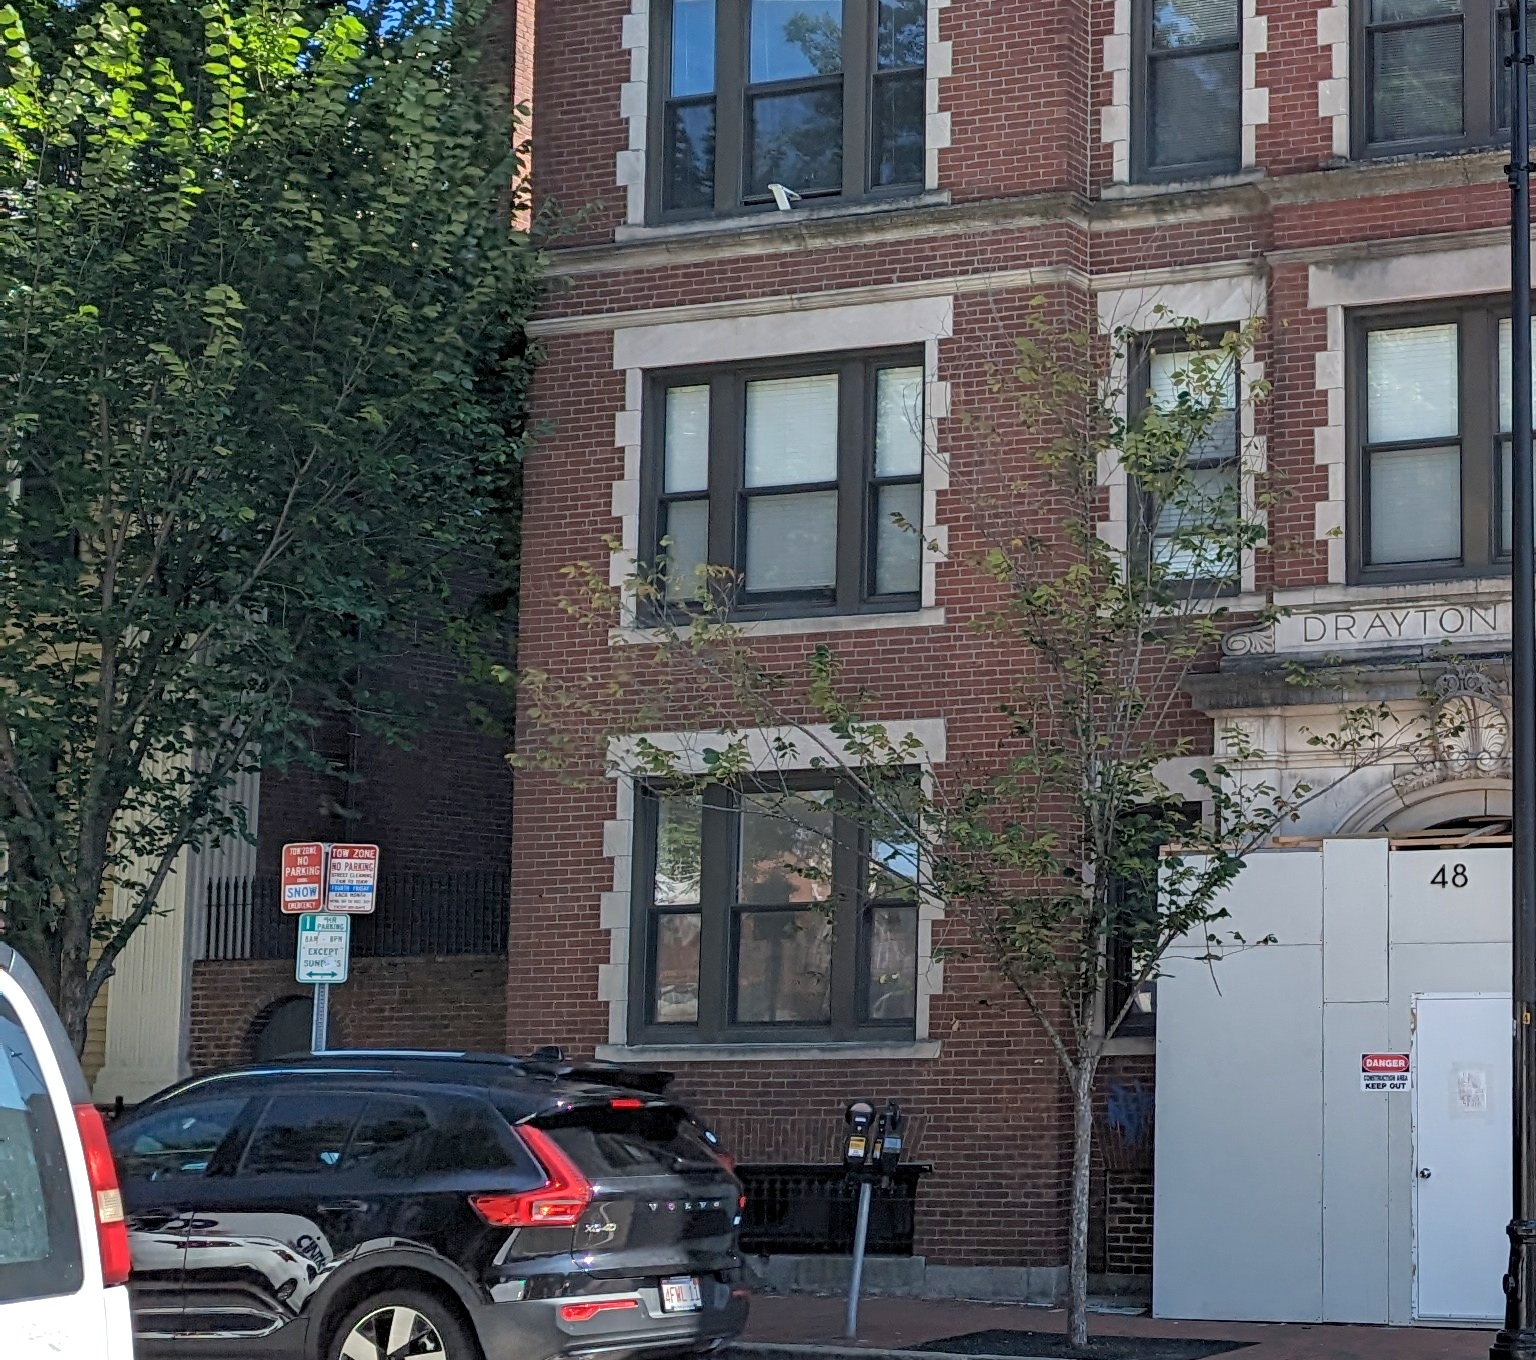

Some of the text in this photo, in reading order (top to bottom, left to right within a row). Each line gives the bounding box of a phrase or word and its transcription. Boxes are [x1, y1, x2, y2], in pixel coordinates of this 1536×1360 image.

[1303, 604, 1497, 643] DRAYTON
[332, 848, 376, 858] TOW ZONE
[297, 856, 309, 866] NO
[286, 865, 320, 877] PARKING
[331, 862, 373, 872] NO PARKING
[1430, 863, 1468, 888] 48
[287, 886, 318, 898] SNOW
[317, 923, 344, 931] PARKING
[308, 947, 339, 955] EXCEPT
[1366, 1058, 1406, 1068] DANGER
[1365, 1082, 1387, 1090] KEEP
